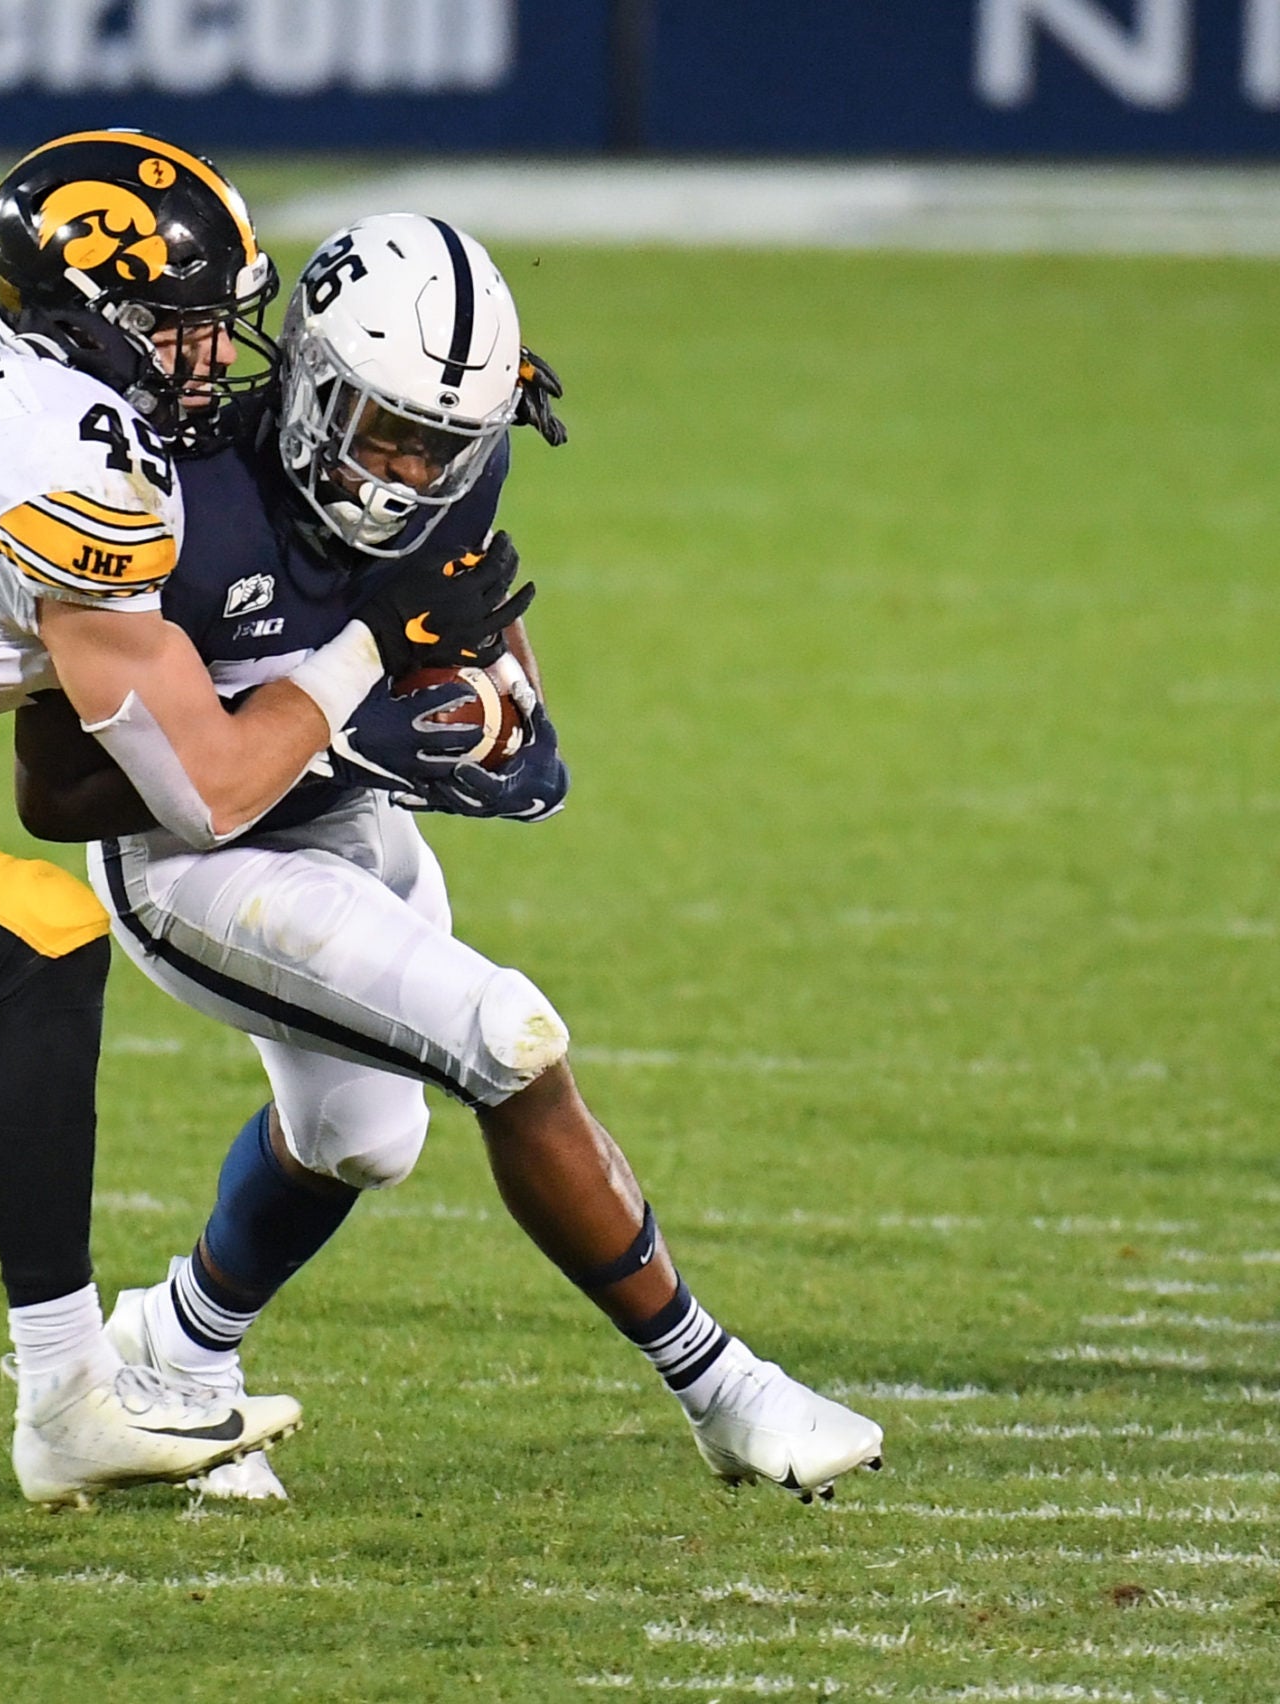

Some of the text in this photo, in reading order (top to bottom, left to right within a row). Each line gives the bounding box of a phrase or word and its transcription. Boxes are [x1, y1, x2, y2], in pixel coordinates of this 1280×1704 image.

[300, 233, 368, 316] 26
[79, 403, 173, 497] 49
[72, 545, 133, 578] JHF
